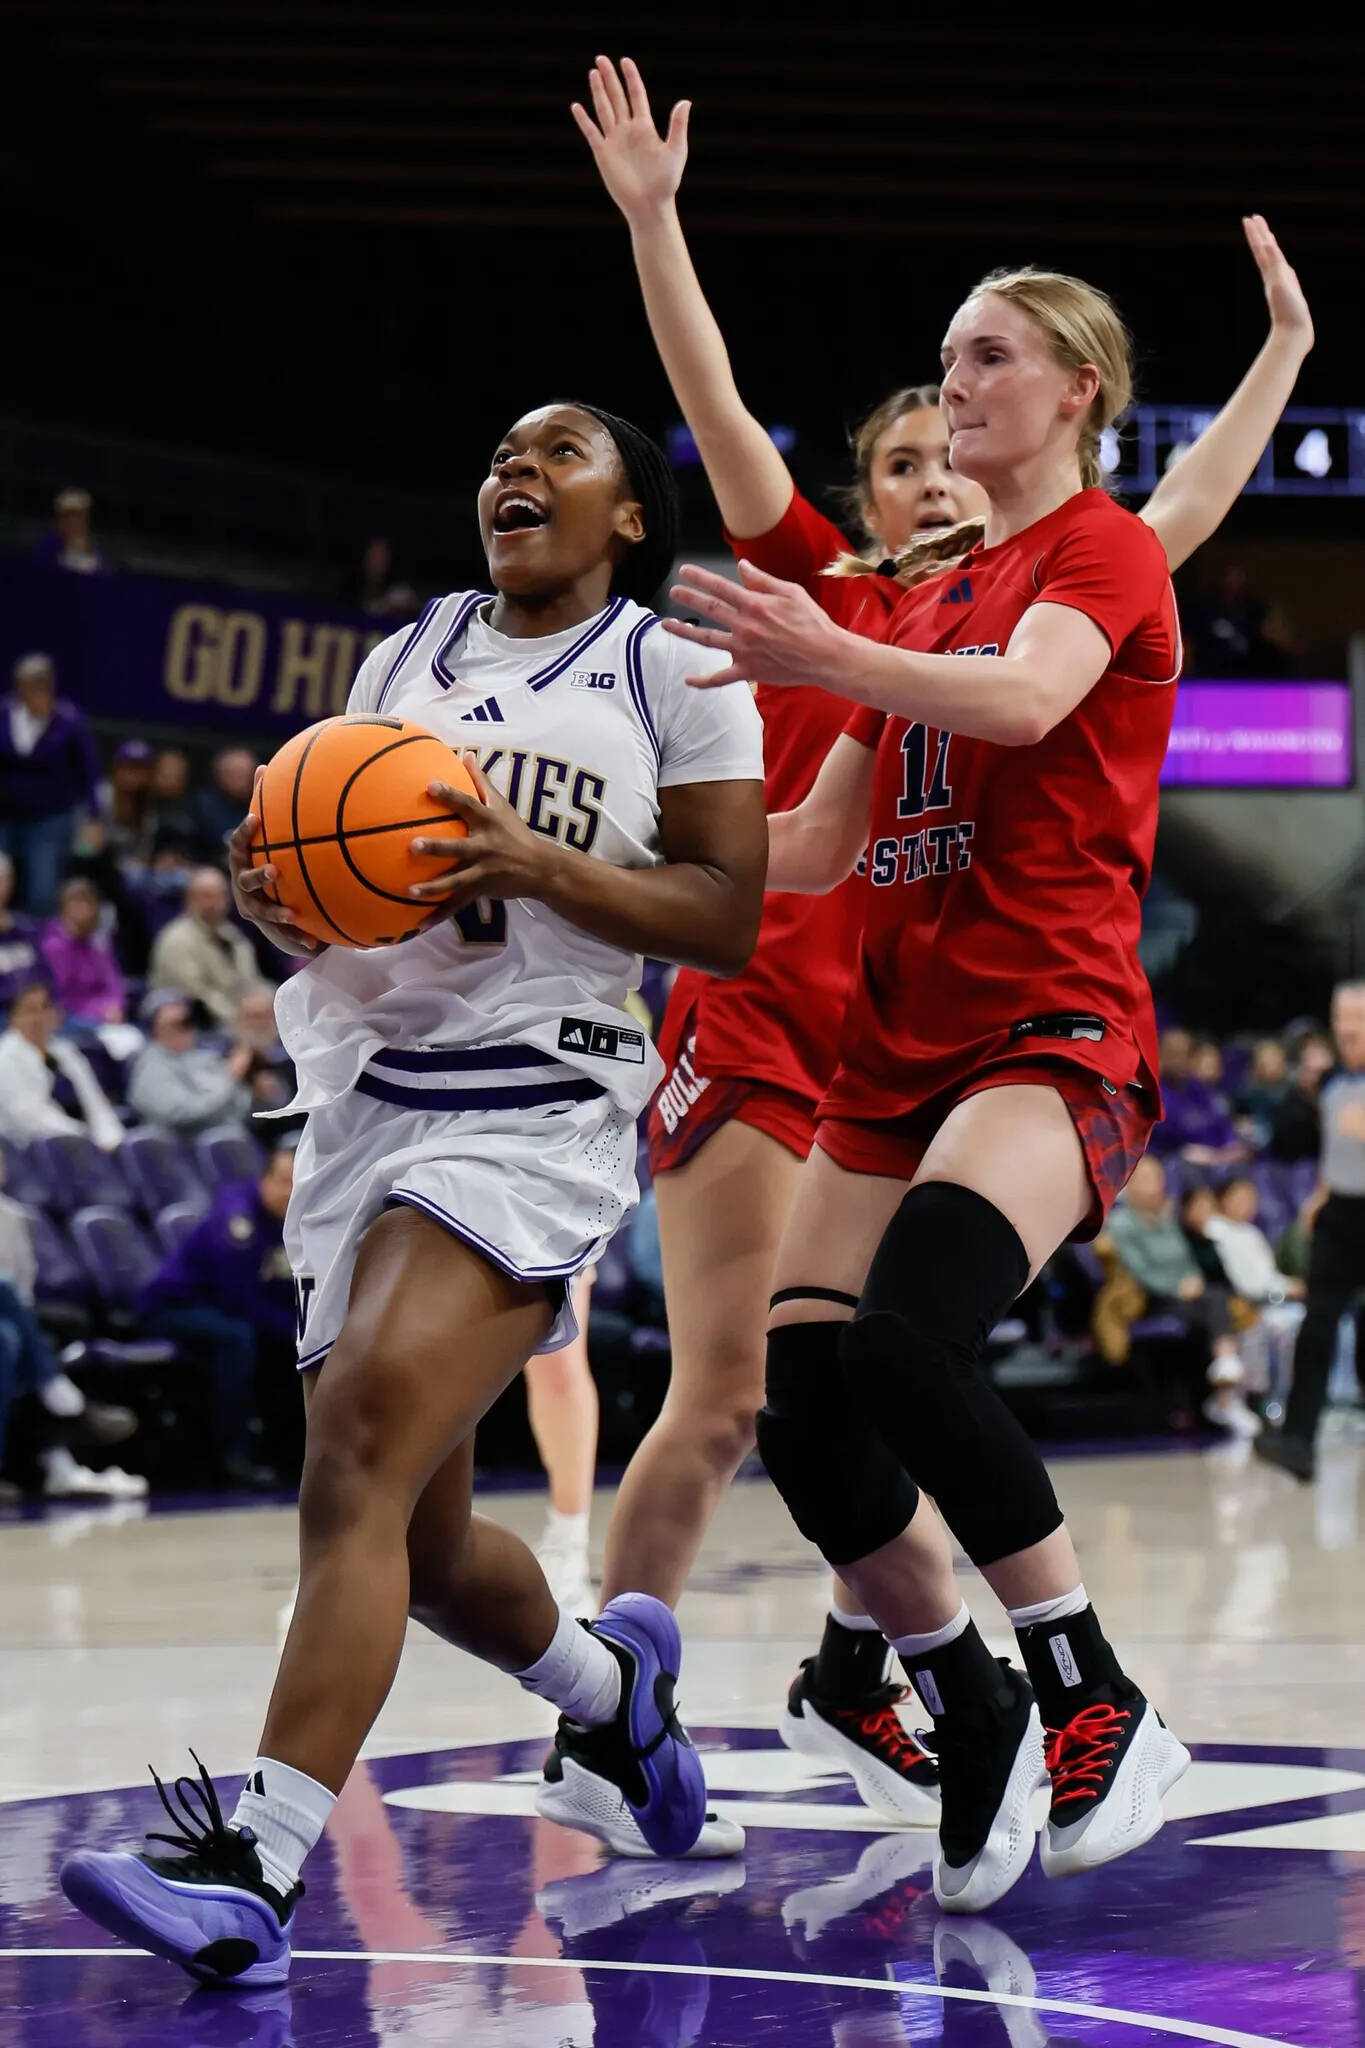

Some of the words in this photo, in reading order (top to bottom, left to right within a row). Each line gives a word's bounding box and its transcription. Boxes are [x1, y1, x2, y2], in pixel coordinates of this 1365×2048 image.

[165, 603, 267, 708] GO
[571, 670, 616, 690] BIG
[657, 1035, 712, 1136] BULL
